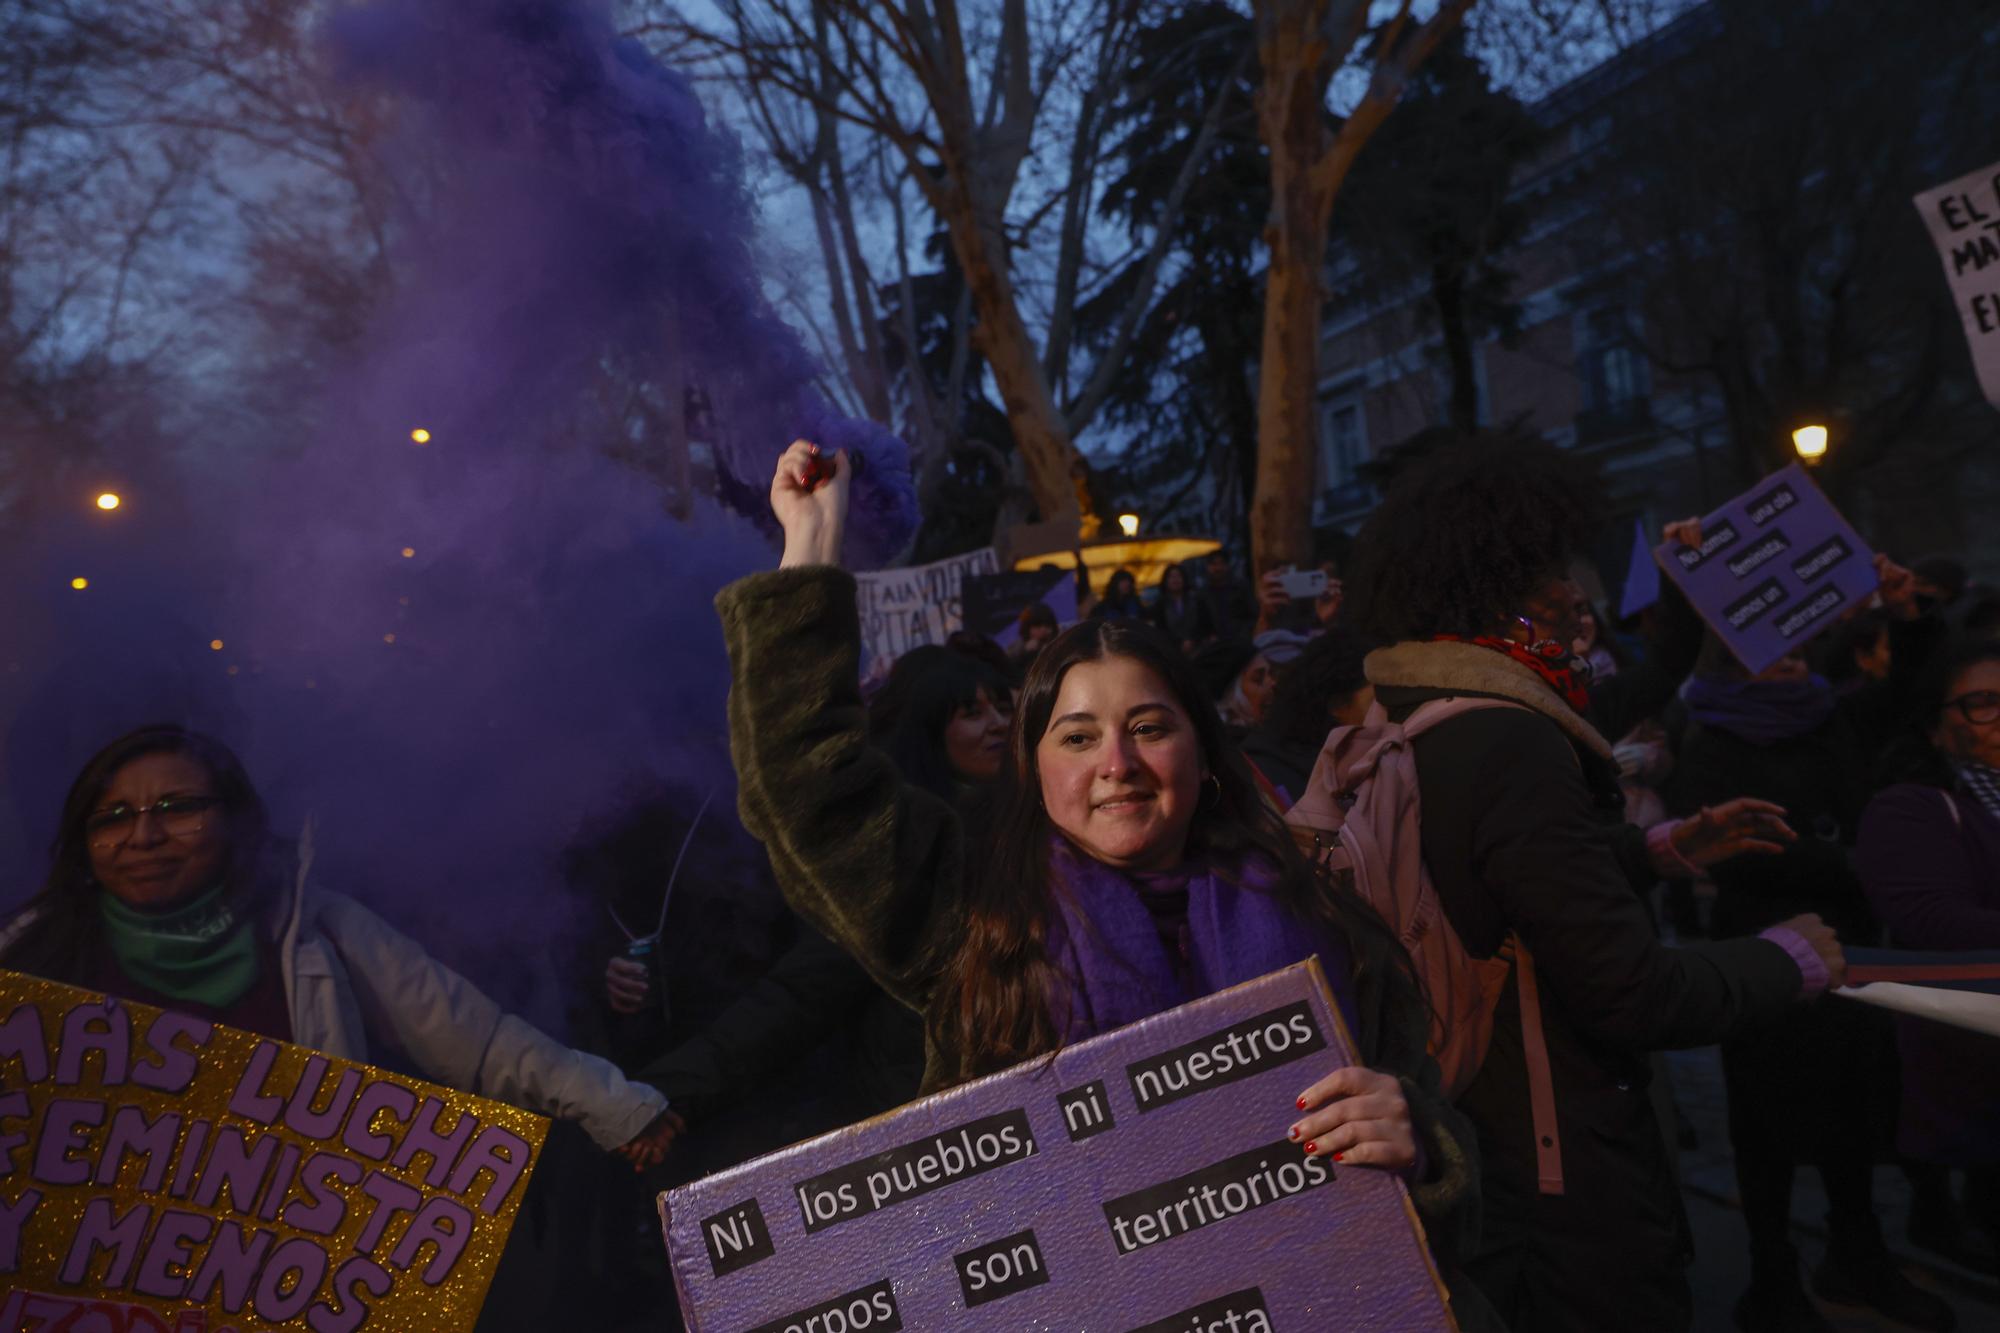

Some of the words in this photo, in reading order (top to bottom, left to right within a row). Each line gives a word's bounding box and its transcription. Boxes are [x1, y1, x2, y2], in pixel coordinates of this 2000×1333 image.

[1941, 194, 1989, 231] EL
[228, 1039, 532, 1217] LUCHA
[710, 1210, 755, 1260] Ni
[799, 1186, 857, 1226] los
[866, 1122, 1034, 1209] pueblos,
[1064, 1085, 1104, 1132] ni
[1134, 1011, 1314, 1103] nuestros
[58, 1195, 394, 1333] MENOS
[966, 1242, 1040, 1291] son
[1113, 1153, 1329, 1252] territorios
